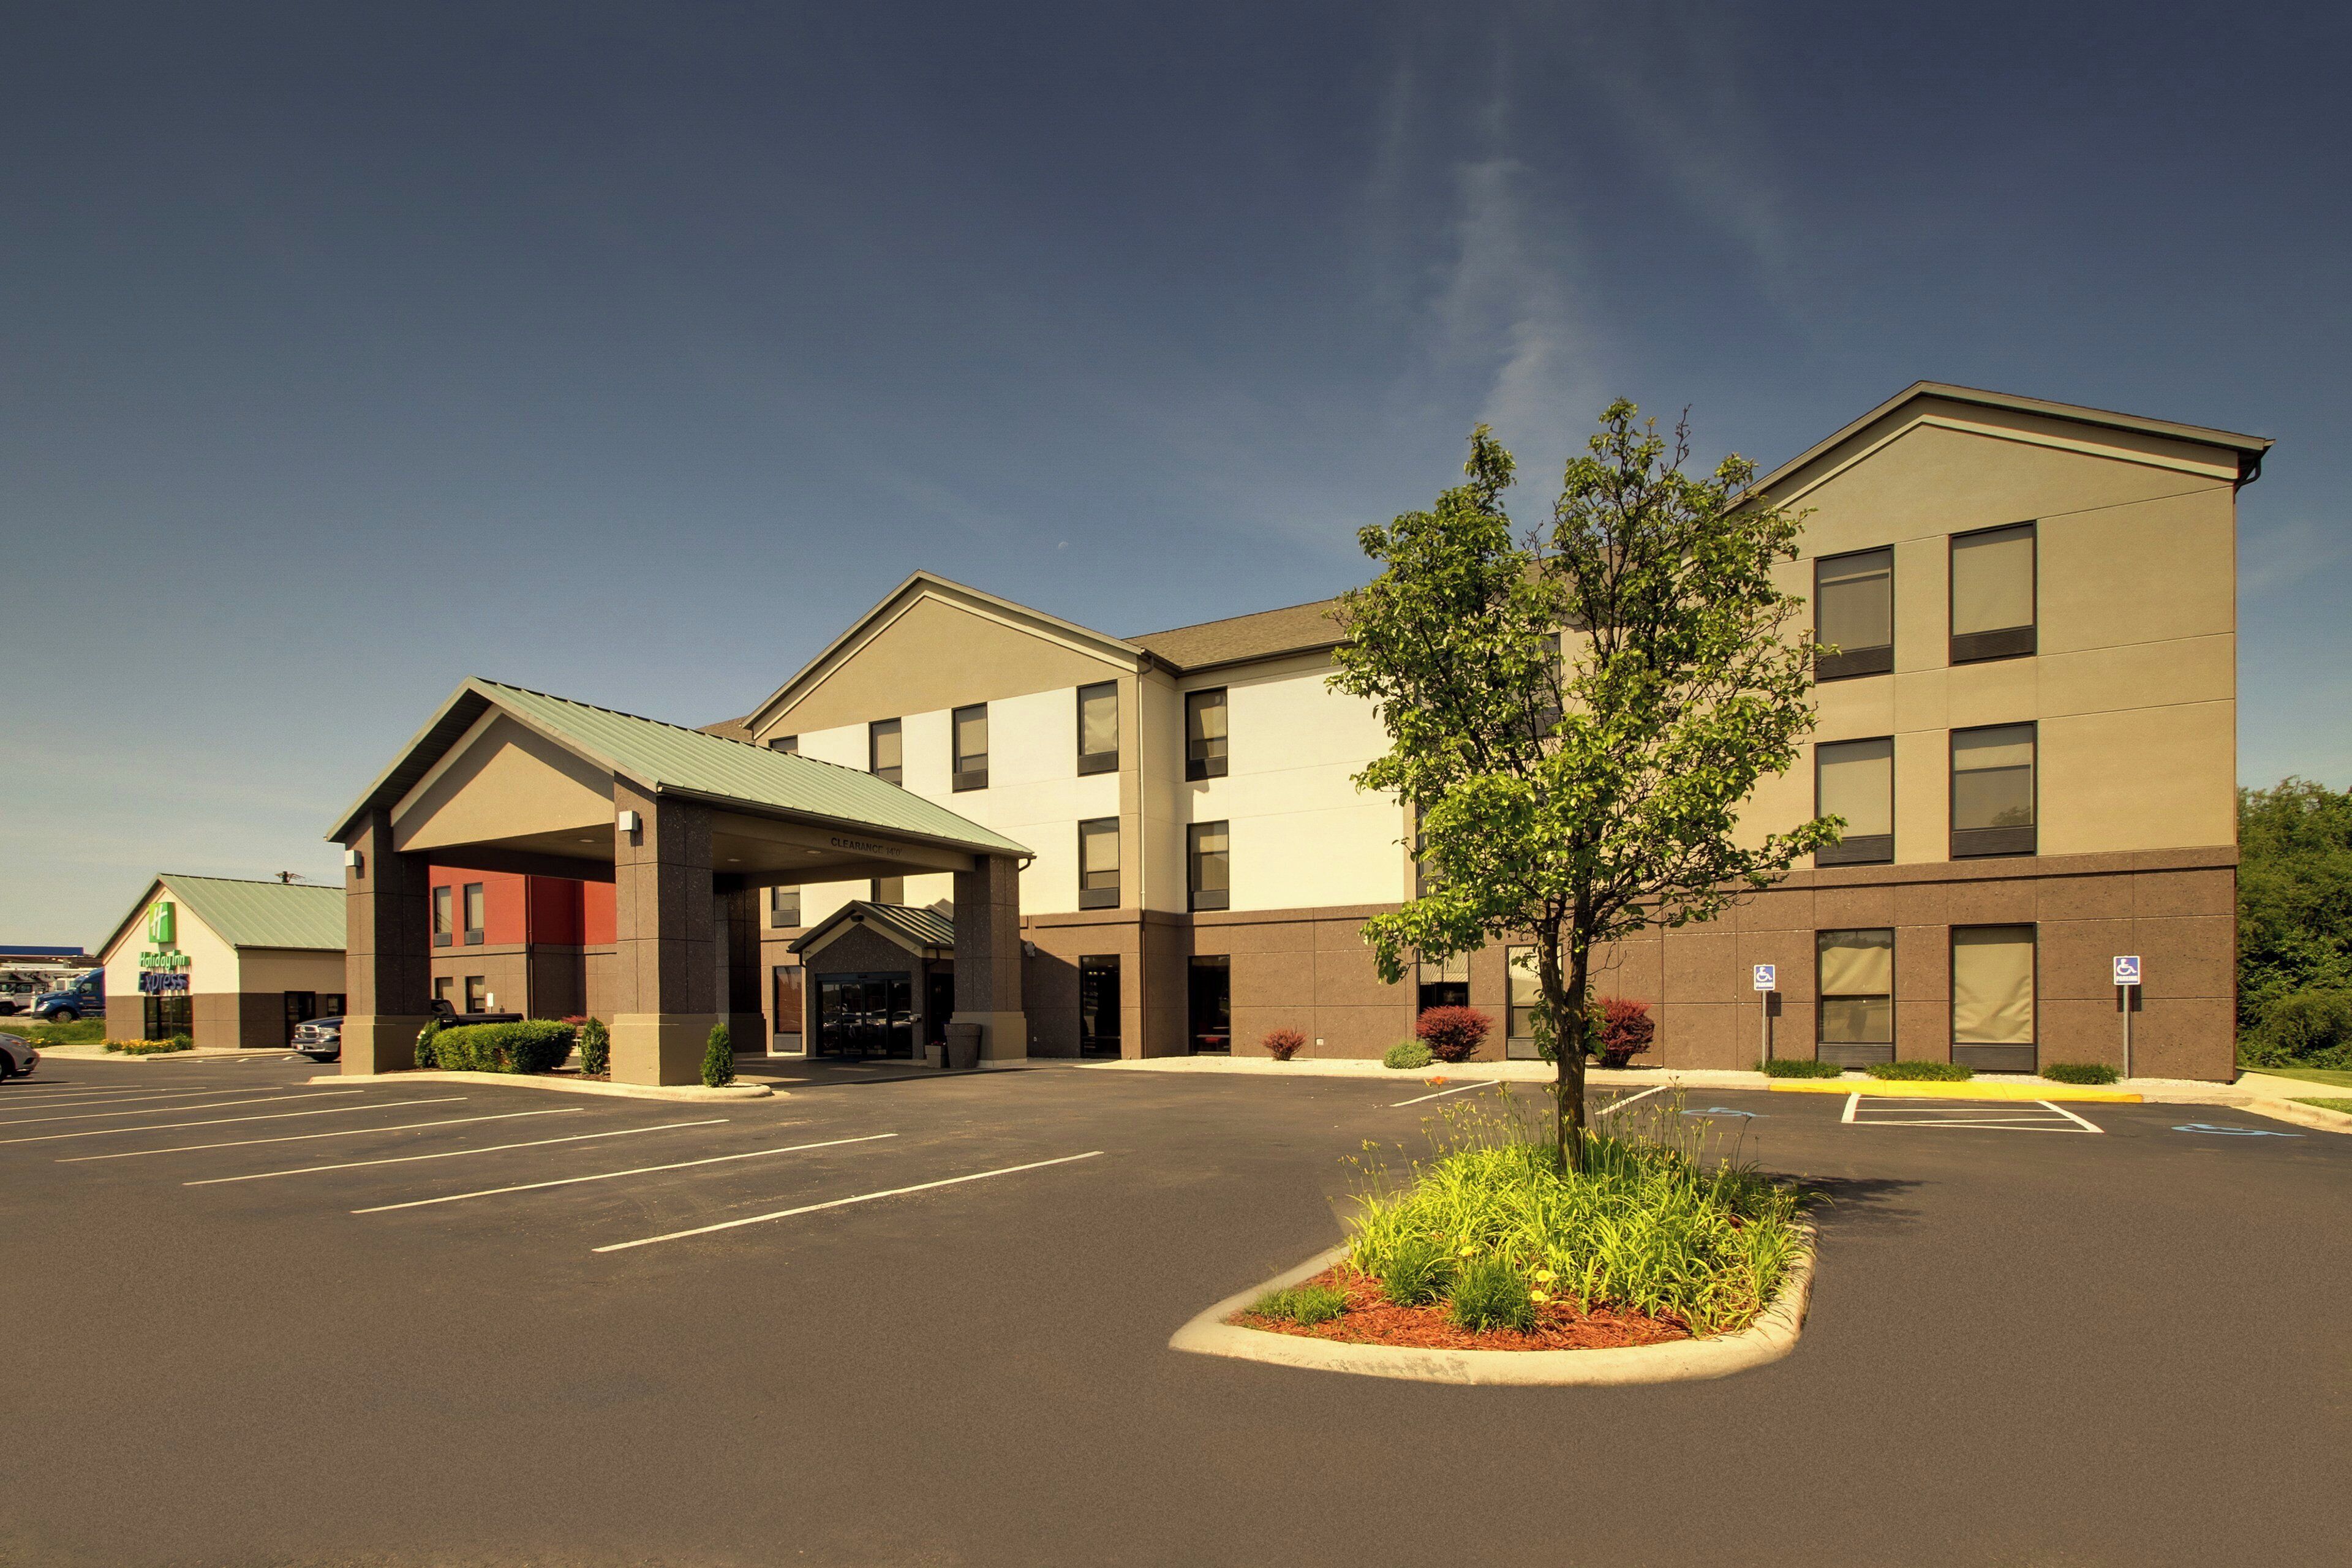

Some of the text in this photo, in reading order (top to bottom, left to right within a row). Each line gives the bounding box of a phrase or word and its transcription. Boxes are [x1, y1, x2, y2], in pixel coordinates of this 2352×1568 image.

[831, 837, 883, 853] CLEARANCE
[139, 949, 186, 970] Holiday Inn
[139, 972, 186, 993] Express
